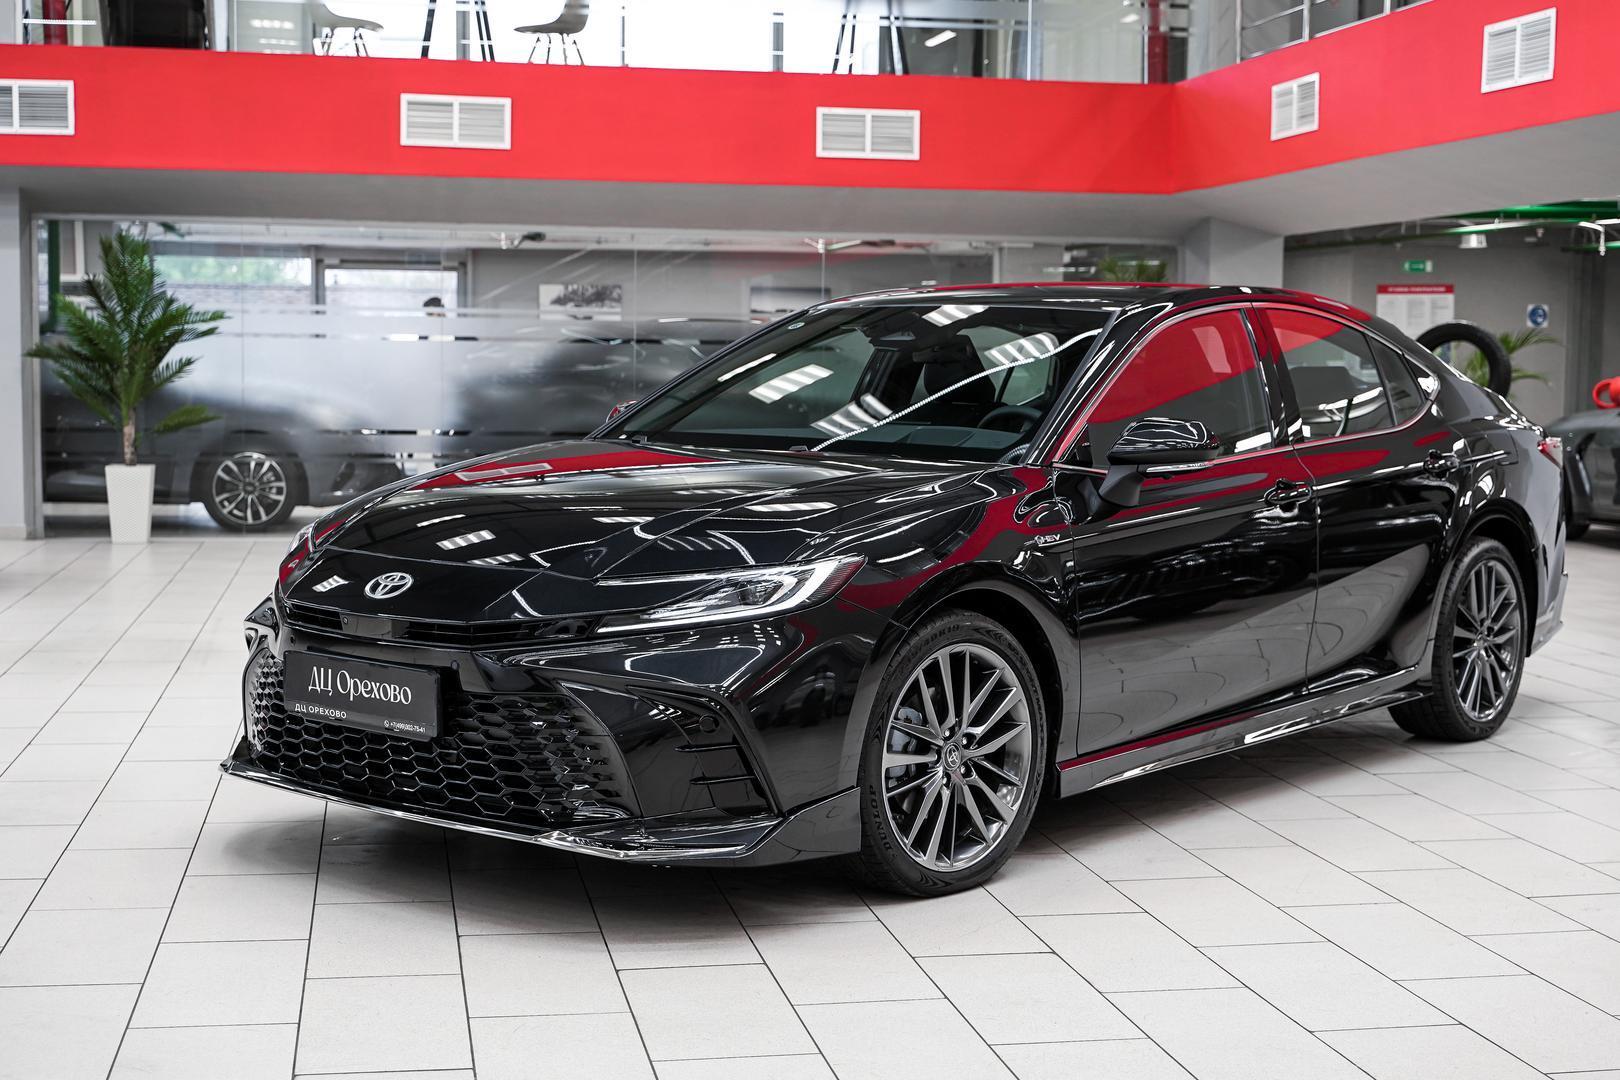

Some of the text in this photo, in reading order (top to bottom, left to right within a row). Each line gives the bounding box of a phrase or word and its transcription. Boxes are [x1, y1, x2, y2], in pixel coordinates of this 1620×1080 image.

[308, 666, 412, 705] ДЦ Орехово
[294, 703, 347, 718] ДЦ ОРЕХОВО
[868, 782, 892, 855] DUNLOP
